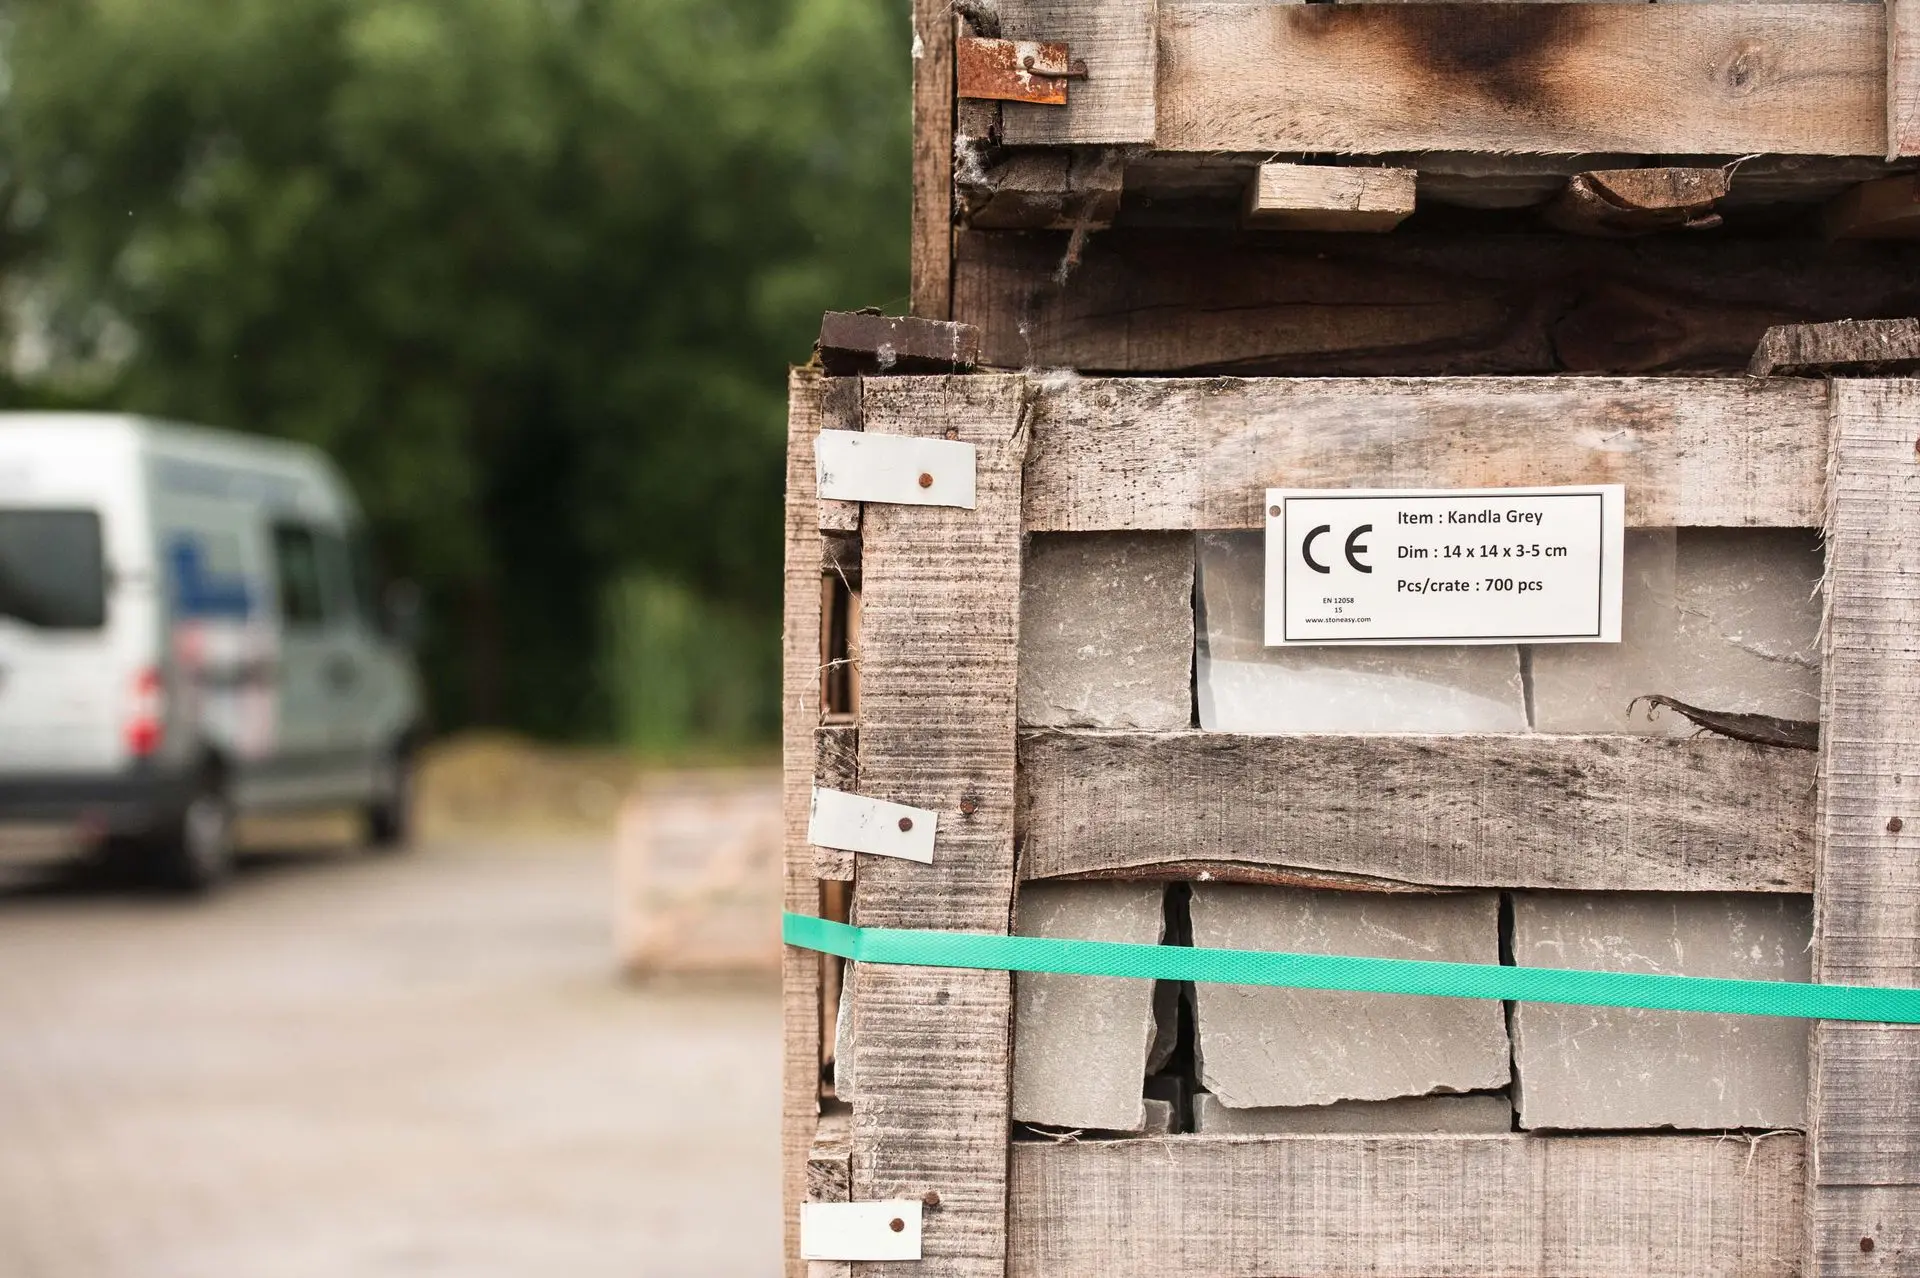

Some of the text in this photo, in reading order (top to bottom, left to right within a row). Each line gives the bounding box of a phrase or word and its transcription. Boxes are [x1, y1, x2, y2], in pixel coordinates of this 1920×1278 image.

[1398, 510, 1433, 525] Item
[1448, 509, 1501, 524] Kandla
[1506, 509, 1543, 526] Grey
[1301, 523, 1373, 575] CE
[1397, 545, 1429, 559] Dim
[1443, 544, 1462, 558] 14
[1466, 547, 1475, 558] x
[1479, 544, 1499, 558] 14
[1502, 547, 1512, 558] x
[1515, 544, 1541, 558] 3-5
[1544, 546, 1567, 557] cm
[1397, 578, 1470, 595] Pcs/crate
[1484, 578, 1514, 592] 700
[1518, 580, 1543, 595] pcs
